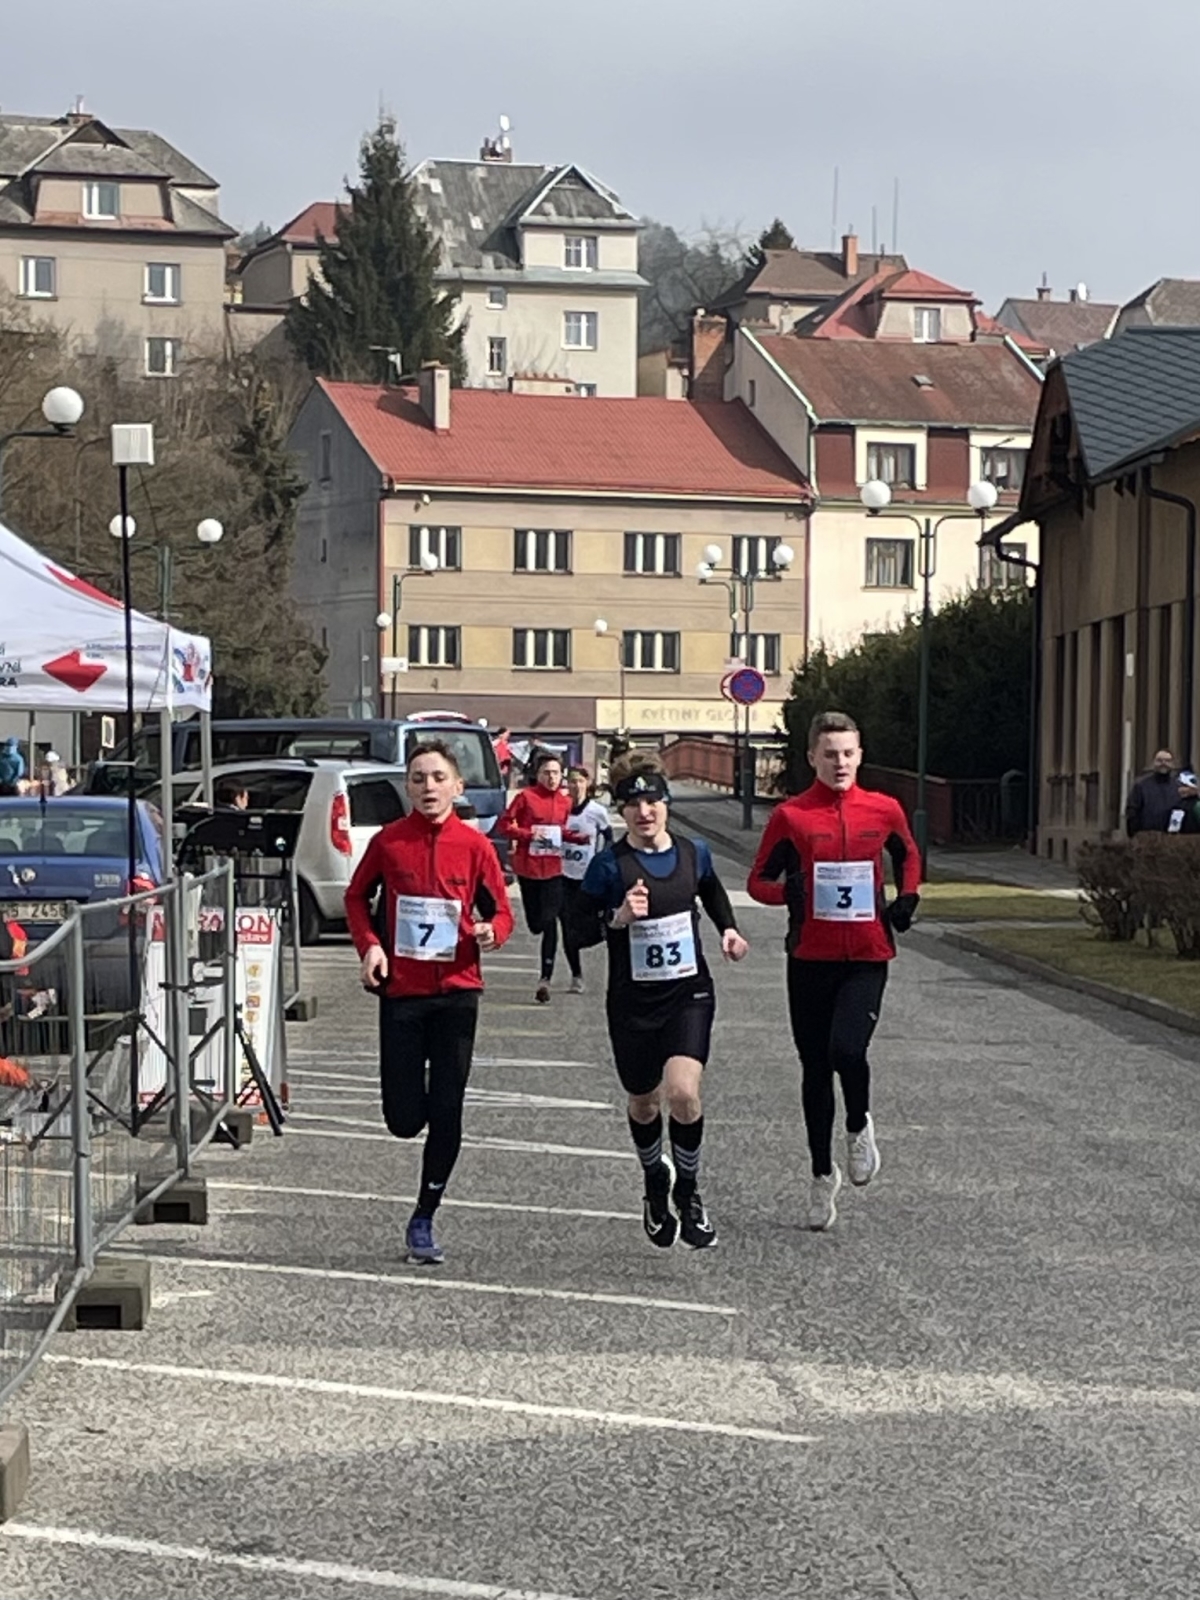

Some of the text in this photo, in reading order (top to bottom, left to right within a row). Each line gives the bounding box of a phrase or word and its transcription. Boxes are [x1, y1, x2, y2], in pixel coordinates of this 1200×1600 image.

[836, 886, 853, 909] 3
[418, 923, 435, 947] 7
[645, 941, 682, 969] 83
